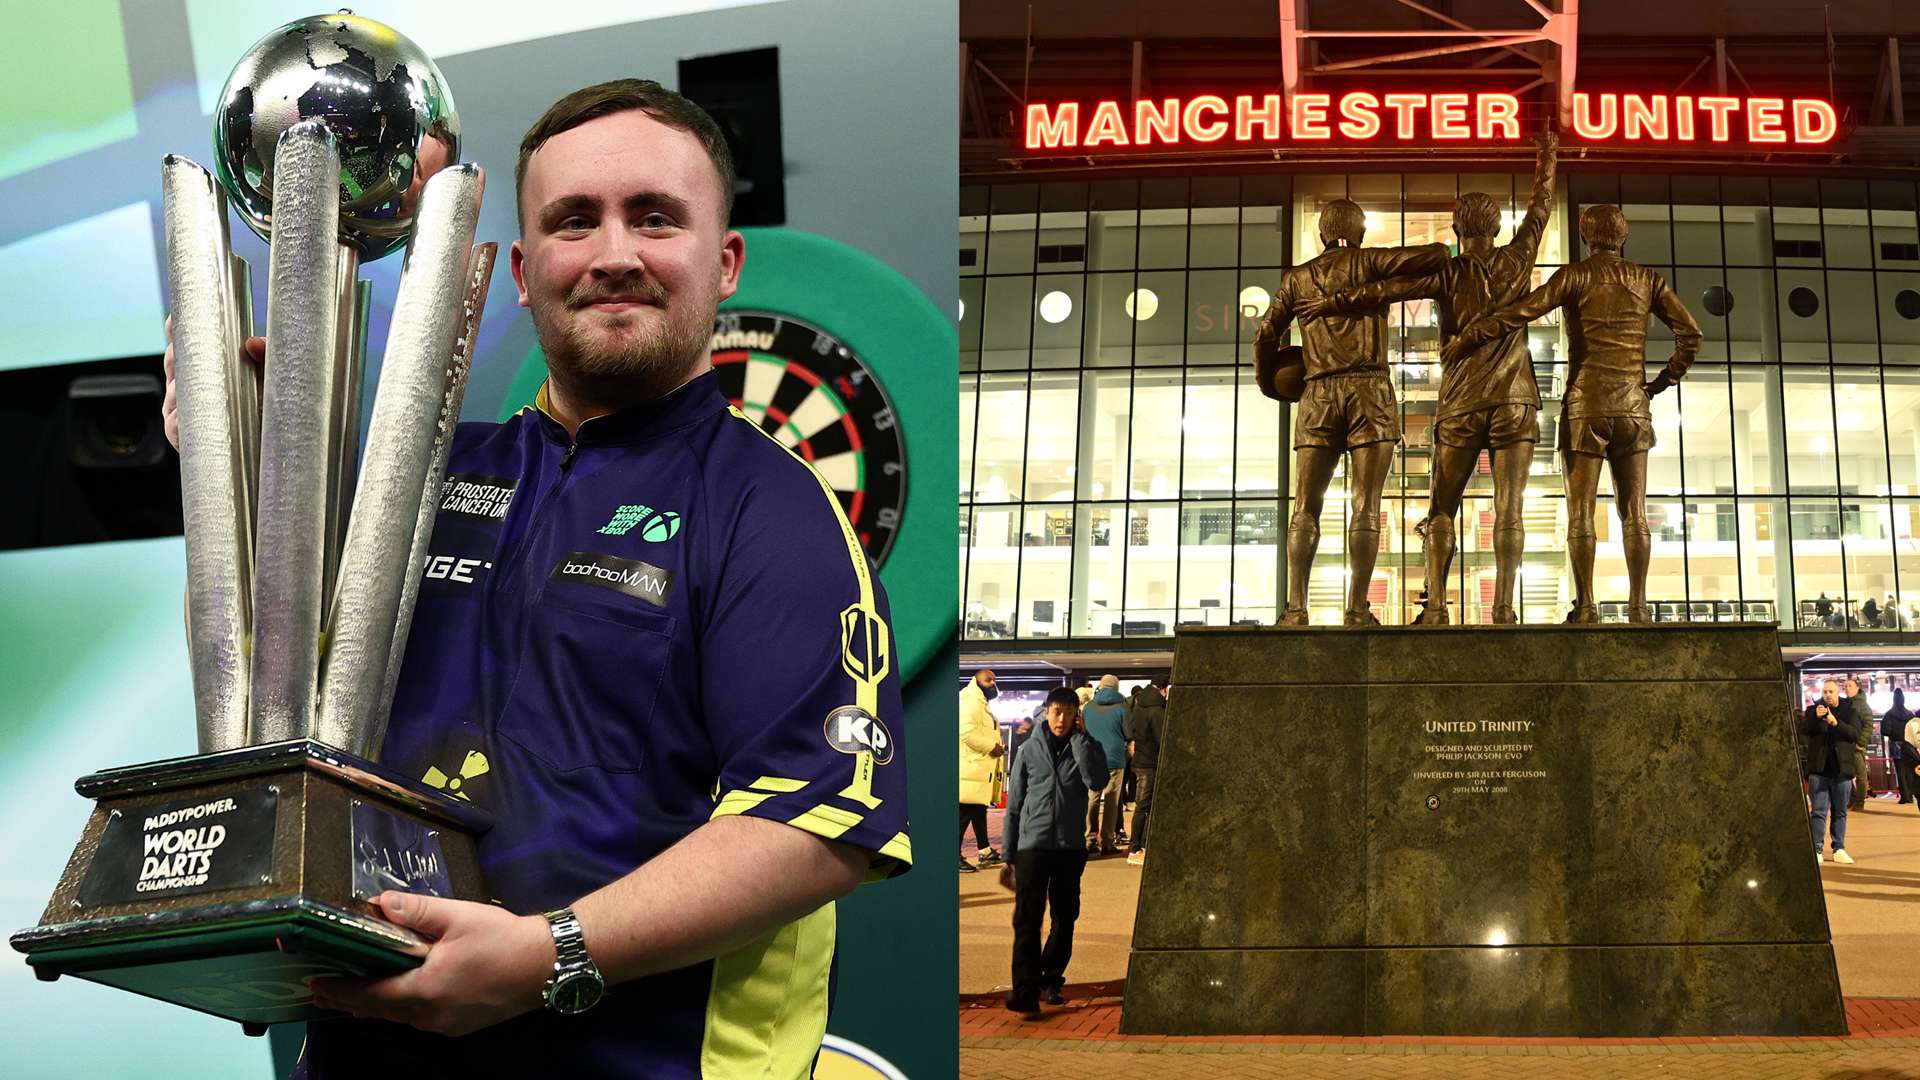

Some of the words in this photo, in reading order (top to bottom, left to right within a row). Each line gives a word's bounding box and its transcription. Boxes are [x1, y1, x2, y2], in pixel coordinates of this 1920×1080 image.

[1025, 92, 1521, 149] MANCHESTER
[1572, 93, 1838, 144] UNITED
[1195, 303, 1259, 332] SIR
[712, 330, 774, 351] nmau
[451, 482, 515, 503] PROSTATE
[442, 496, 493, 515] CANCER
[616, 505, 655, 516] SCORE
[606, 520, 639, 529] WITH
[612, 513, 649, 521] MORE
[596, 526, 627, 535] XBOX
[562, 560, 667, 596] boohooMAN
[838, 716, 887, 752] KP
[1425, 745, 1464, 753] DESIGNED
[1465, 745, 1482, 753] AND
[1483, 744, 1522, 752] SCULPTED
[1464, 753, 1502, 761] JACKSON
[1504, 752, 1522, 760] CVO
[1413, 771, 1453, 779] UNVEILED
[1454, 771, 1465, 779] BY
[1502, 770, 1547, 778] FERGUSON
[144, 825, 226, 857] WORLD
[140, 849, 214, 881] DARTS
[136, 874, 208, 892] CHAMPIONSHIP
